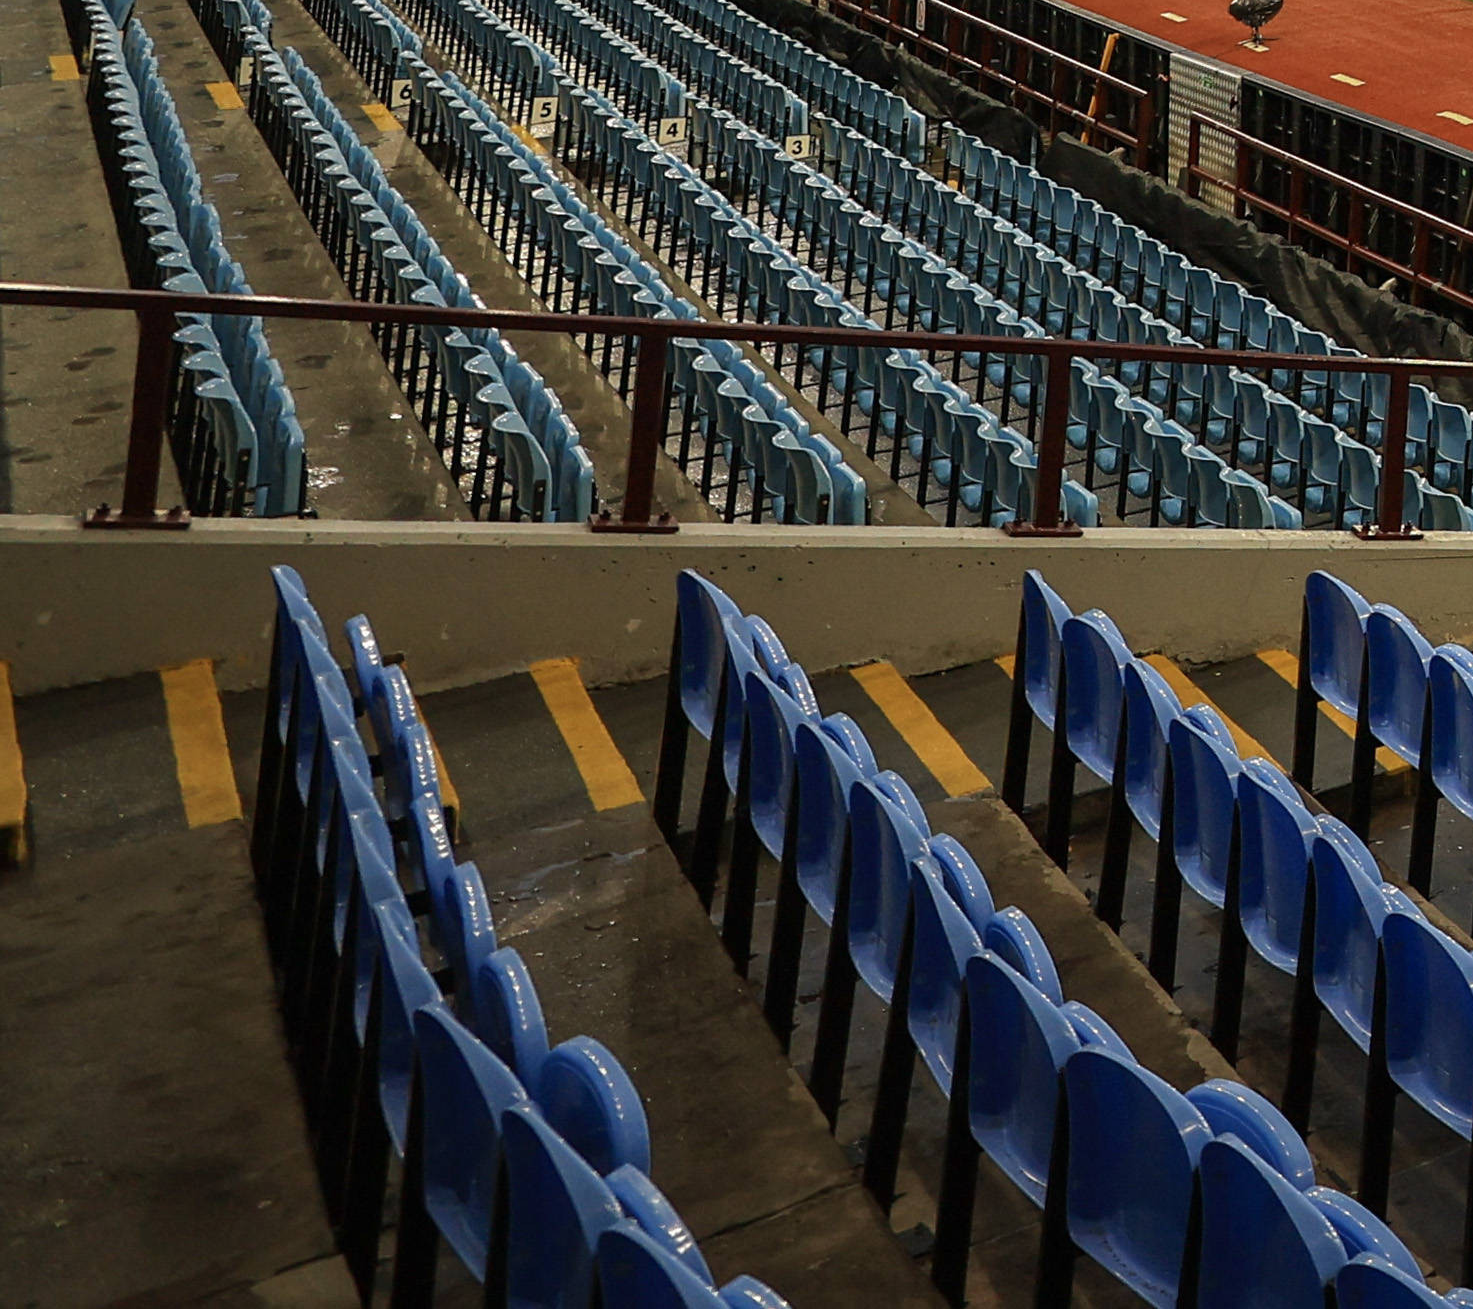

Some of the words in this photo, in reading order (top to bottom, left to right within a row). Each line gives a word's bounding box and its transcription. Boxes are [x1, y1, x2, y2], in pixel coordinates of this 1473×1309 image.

[400, 84, 412, 100] 6
[540, 102, 551, 117] 5
[667, 123, 678, 137] 4
[792, 140, 803, 155] 3
